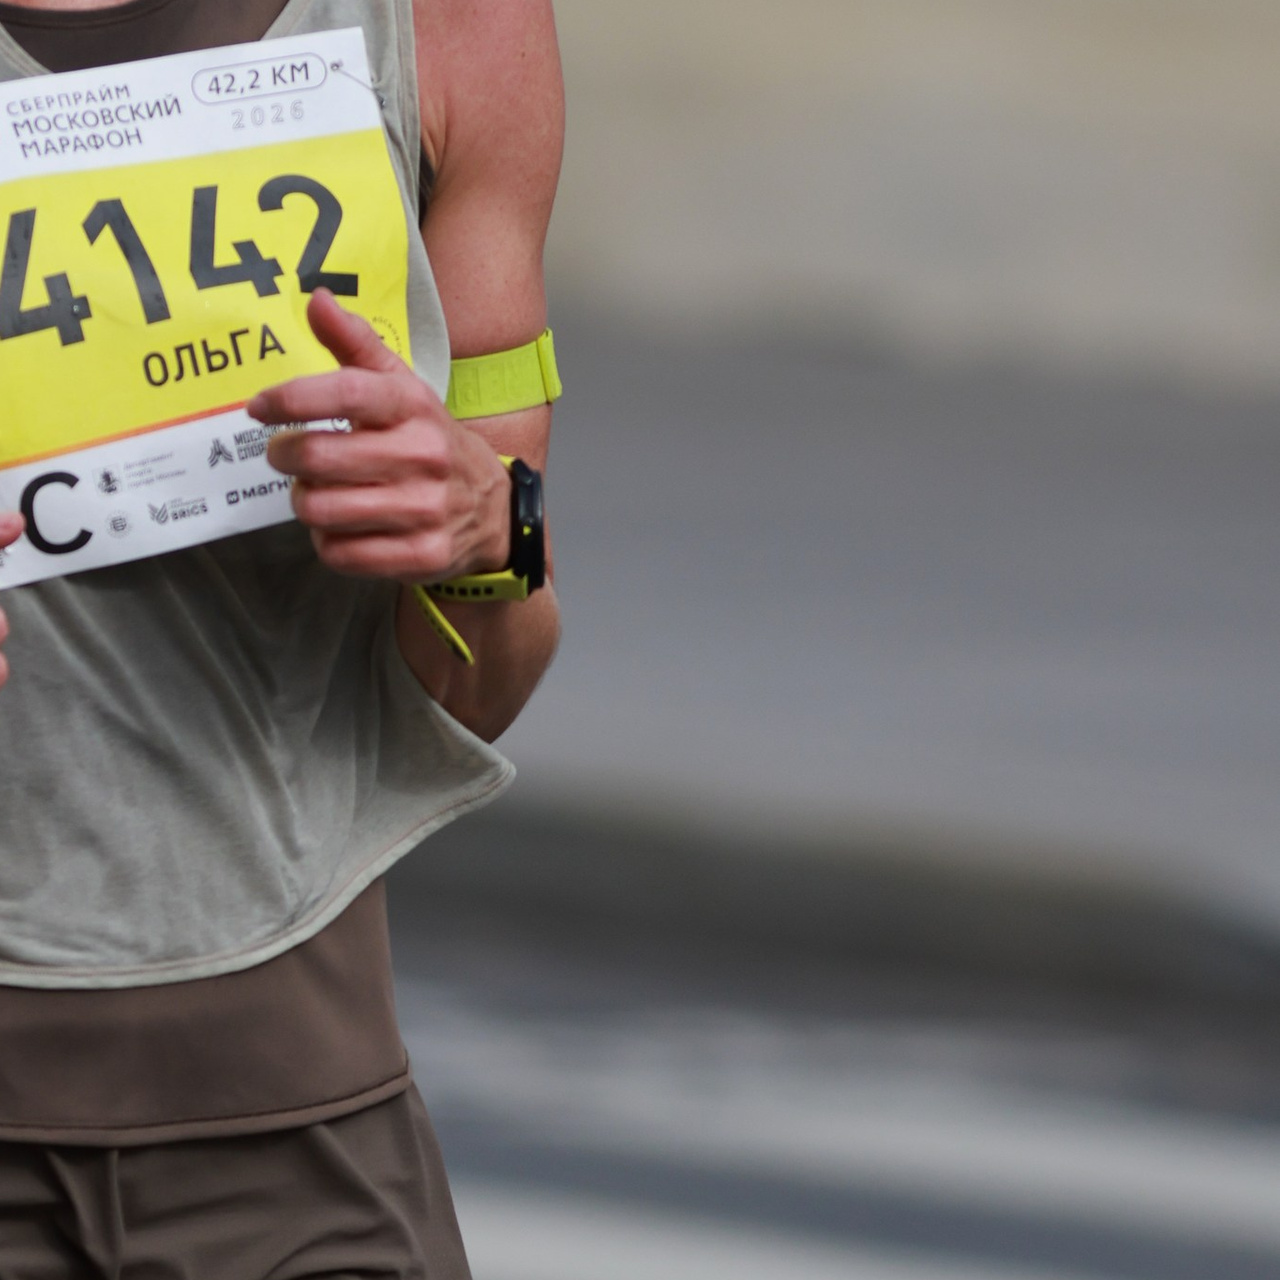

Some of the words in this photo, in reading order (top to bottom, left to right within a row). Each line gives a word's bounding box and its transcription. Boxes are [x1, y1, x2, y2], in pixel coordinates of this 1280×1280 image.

[208, 70, 261, 95] 42,2
[6, 84, 131, 117] СБЕРПРАЙМ
[12, 93, 183, 138] МОСКОВСКИЙ
[230, 99, 305, 131] 2026
[20, 127, 143, 159] МАРАФОН
[142, 323, 287, 387] ОЛЬГА
